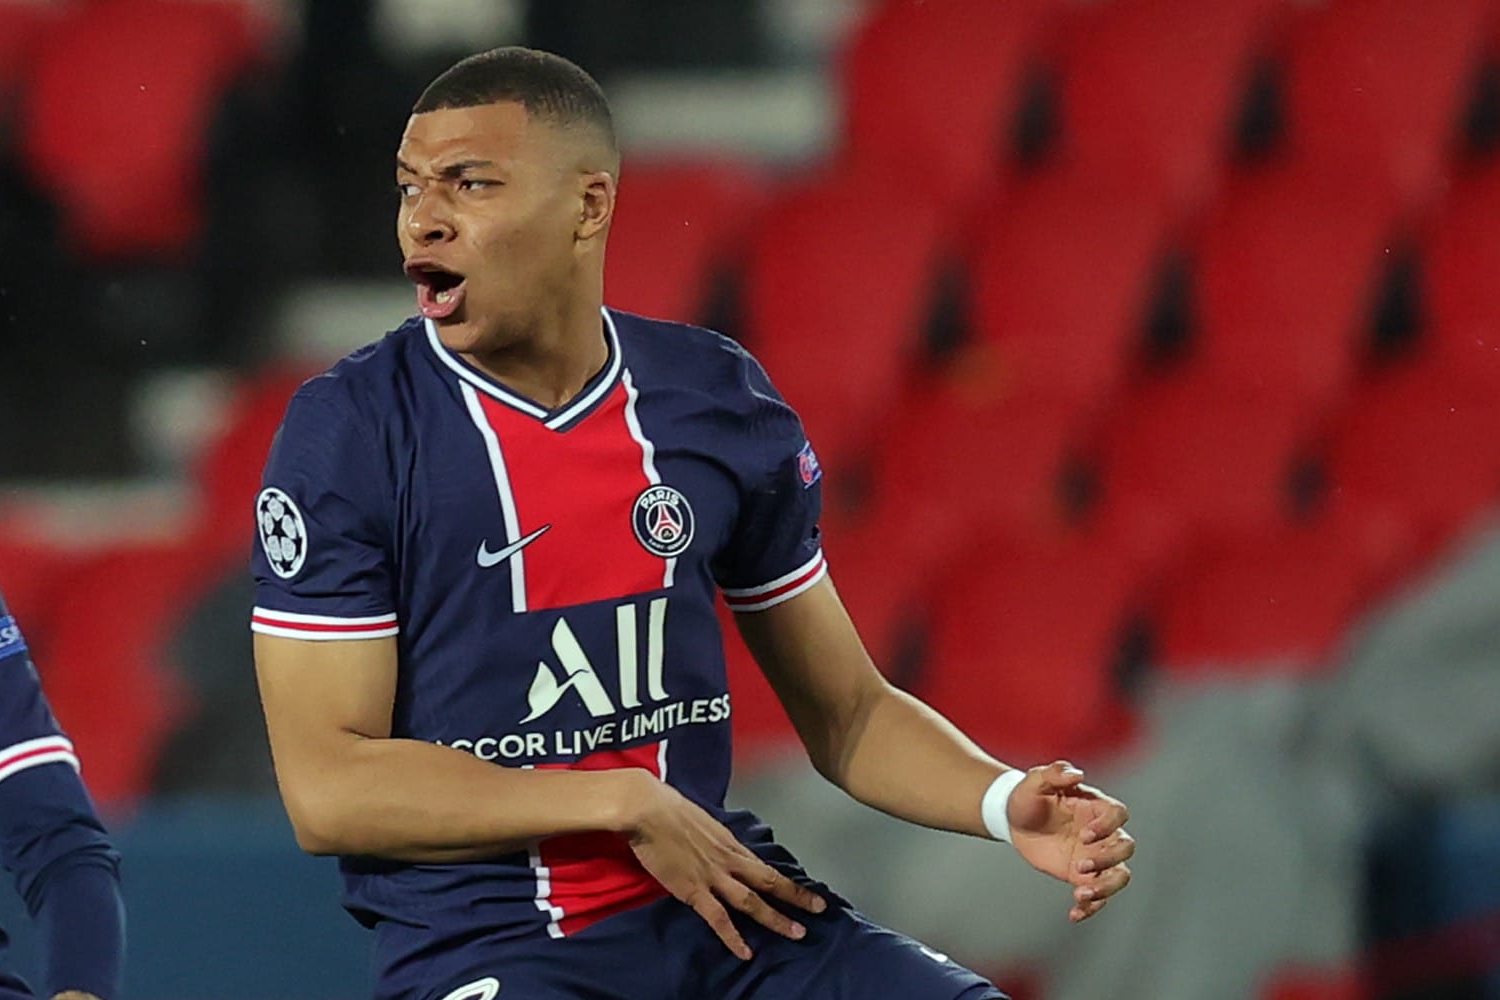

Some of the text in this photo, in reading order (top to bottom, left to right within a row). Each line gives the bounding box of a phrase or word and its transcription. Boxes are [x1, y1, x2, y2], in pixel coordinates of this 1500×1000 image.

[640, 489, 680, 510] PARIS
[436, 694, 731, 761] COR LIVE LIMITLESS
